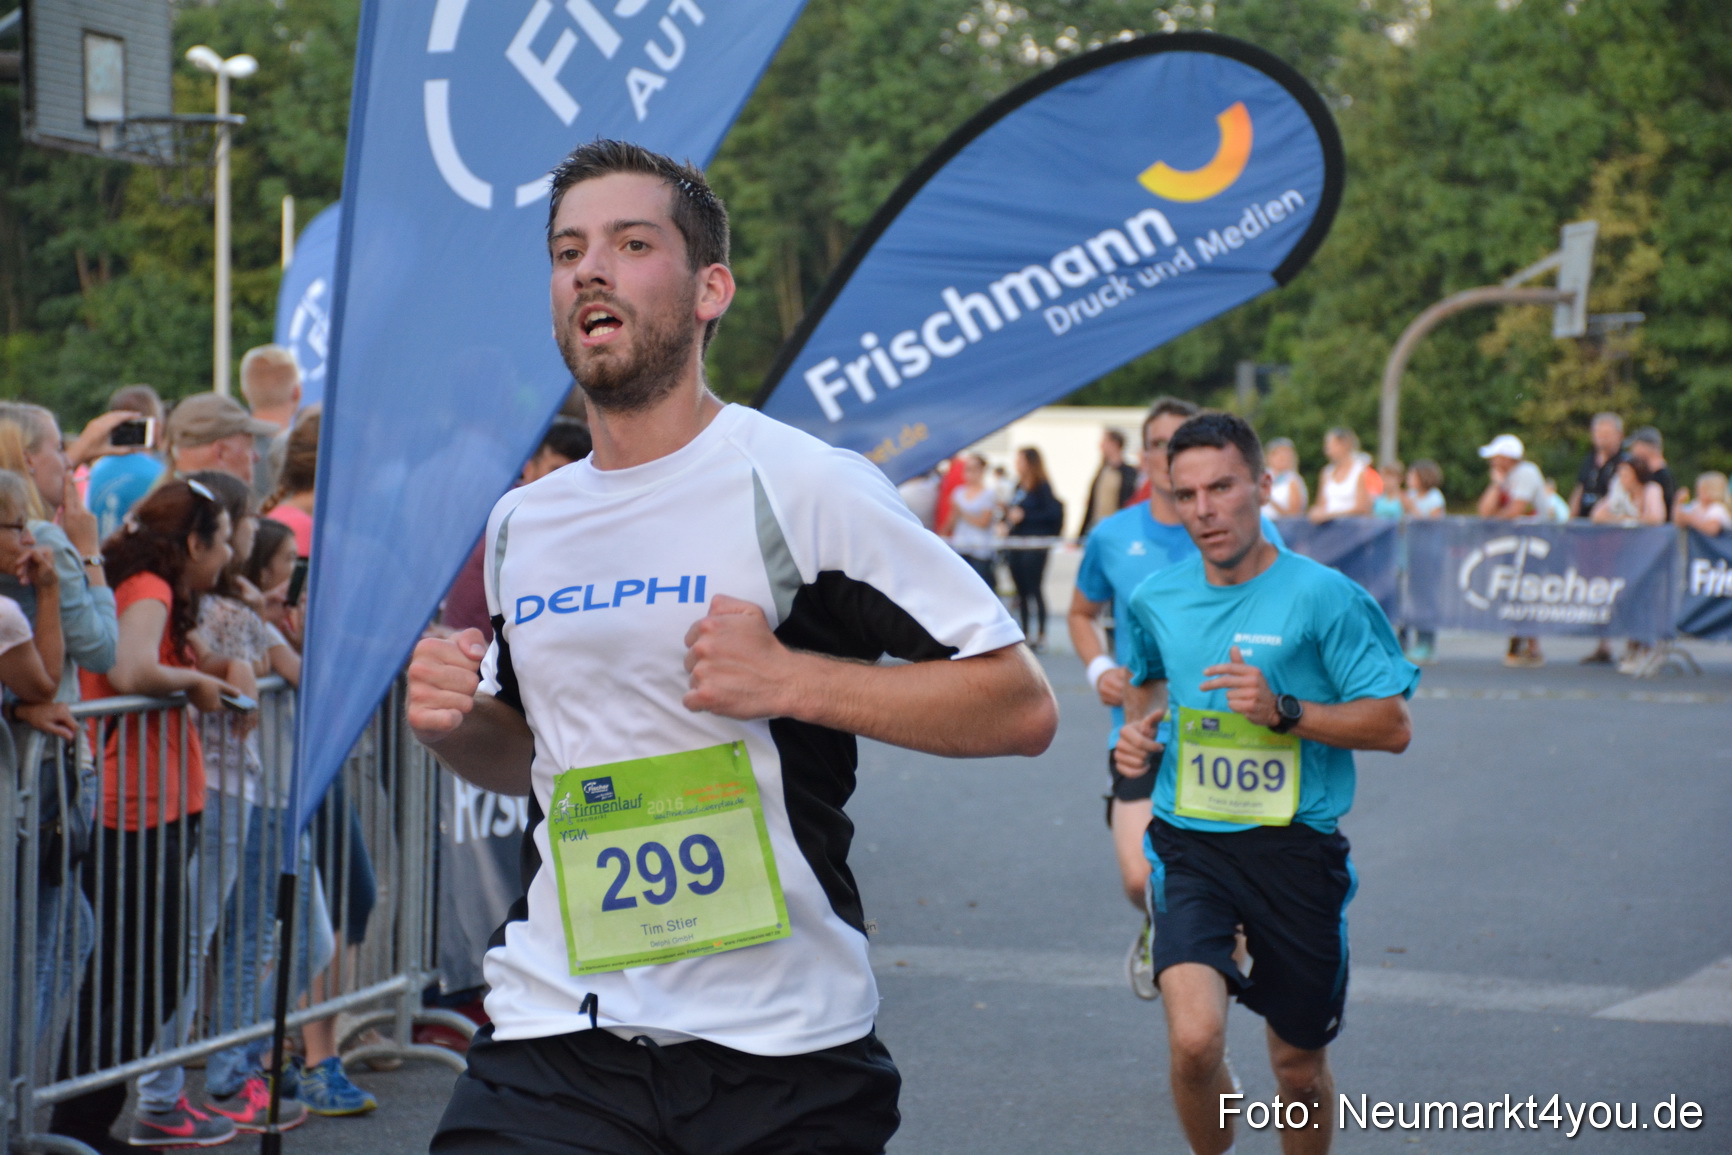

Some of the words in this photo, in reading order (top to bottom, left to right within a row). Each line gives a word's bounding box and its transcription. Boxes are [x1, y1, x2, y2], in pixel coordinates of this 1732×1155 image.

[1042, 271, 1136, 336] Druck
[1136, 245, 1197, 286] und
[1195, 188, 1305, 264] Medien
[802, 208, 1178, 423] Frischmann
[1487, 538, 1627, 606] Fischer
[514, 575, 707, 626] DELPHI
[1190, 753, 1286, 793] 1069
[574, 793, 643, 818] firmenlauf
[646, 797, 684, 815] 2016
[596, 833, 726, 913] 299
[640, 922, 664, 937] Tim
[666, 917, 698, 931] Stier
